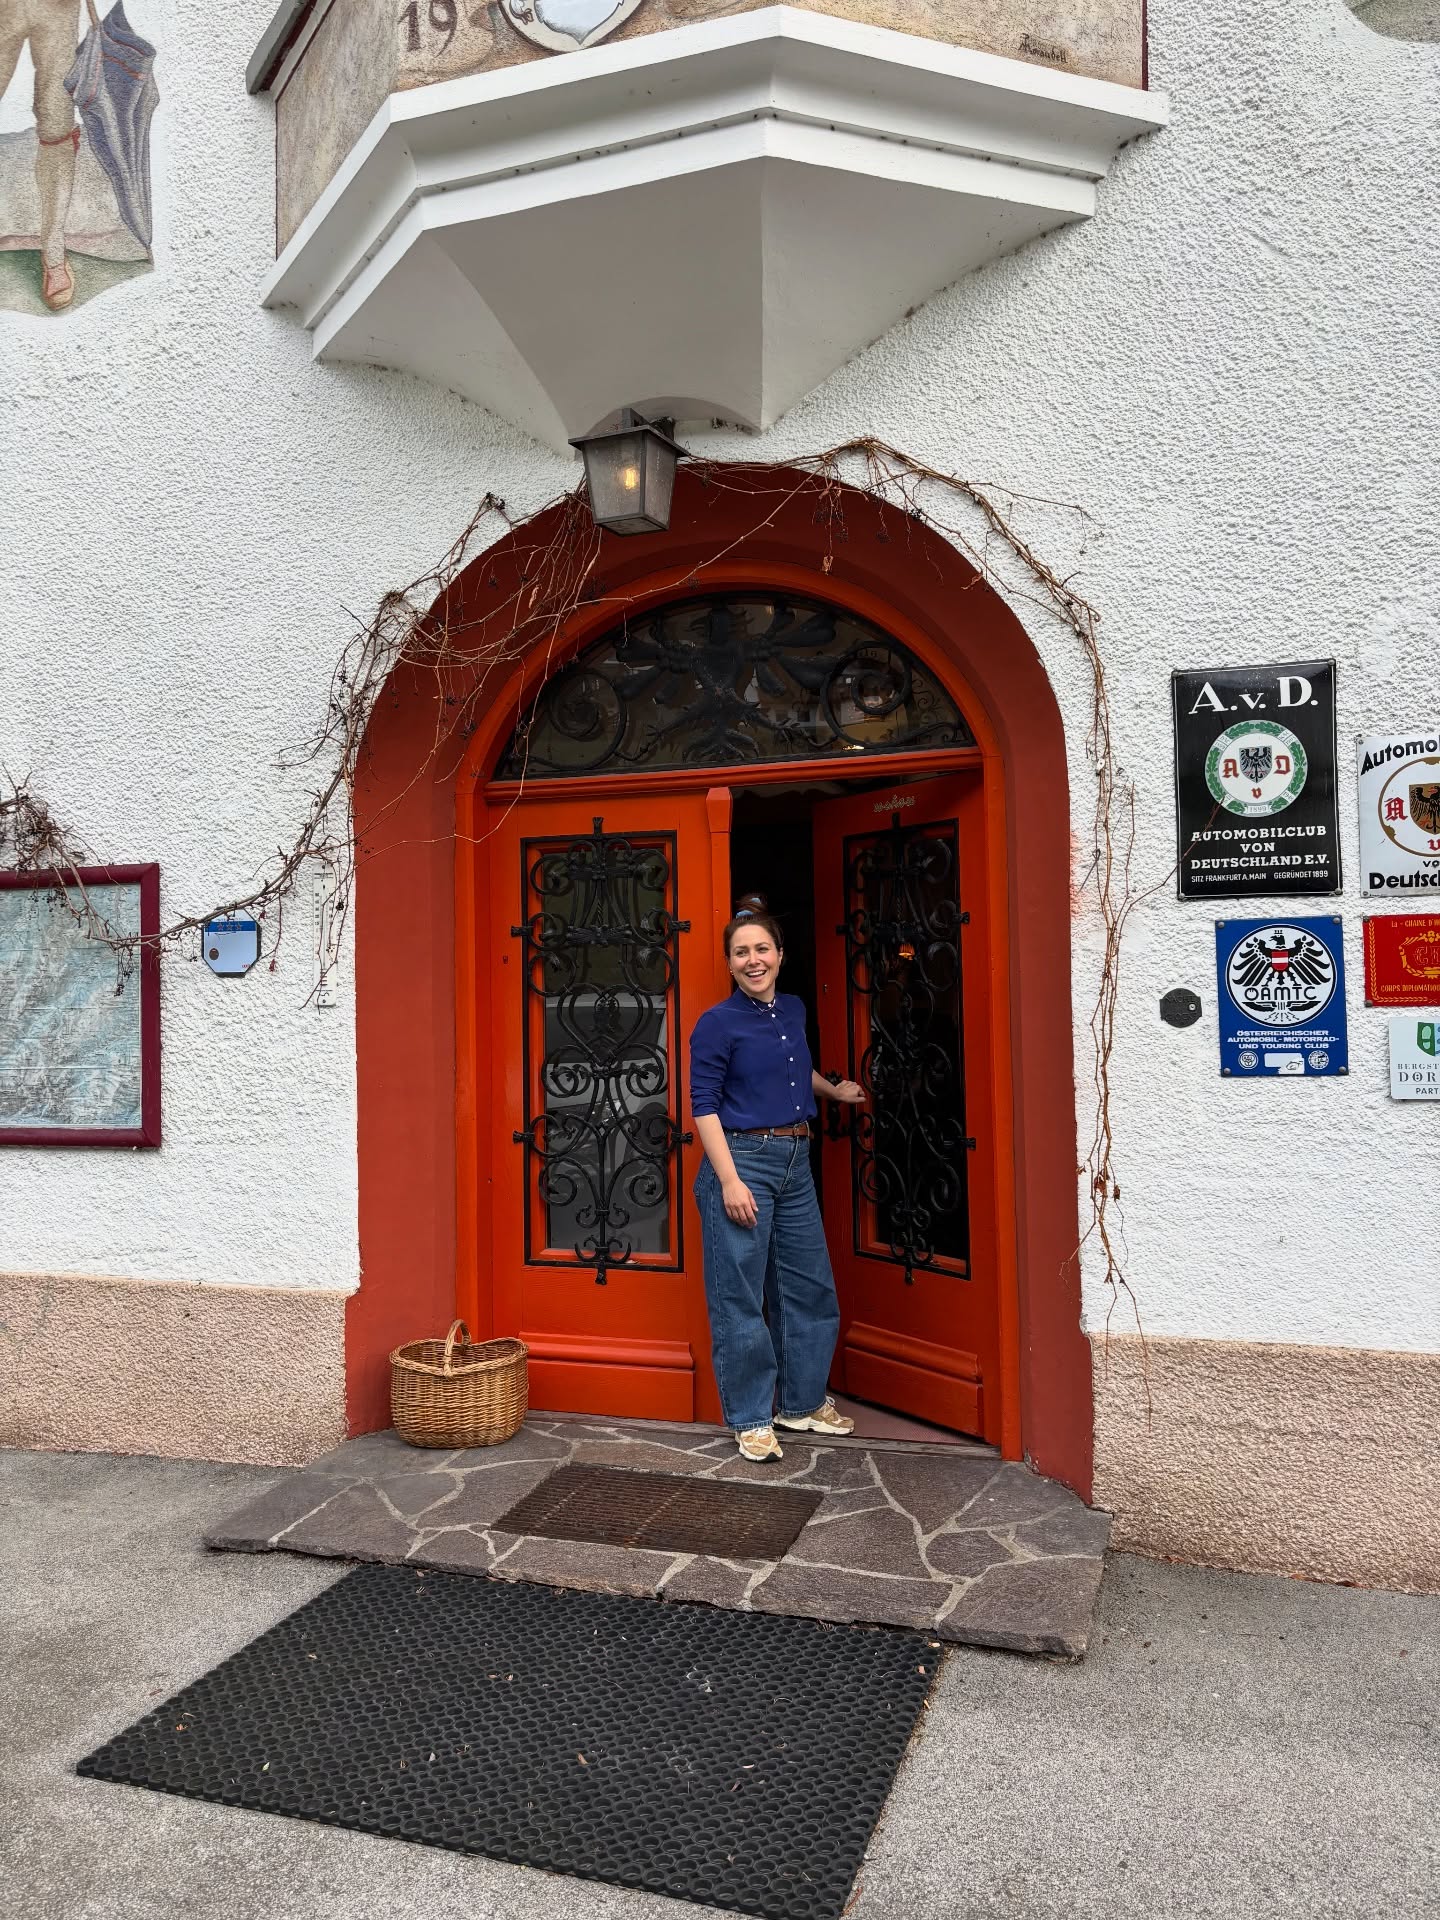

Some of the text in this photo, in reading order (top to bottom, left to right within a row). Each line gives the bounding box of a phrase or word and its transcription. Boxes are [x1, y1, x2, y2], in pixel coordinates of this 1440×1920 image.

[397, 0, 457, 57] 19
[1361, 735, 1440, 776] Automo
[1222, 755, 1291, 778] A D
[1384, 797, 1408, 822] A
[1191, 825, 1327, 841] AUTOMOBILCLUB
[1240, 842, 1276, 853] VON
[1191, 854, 1330, 869] DEUTSCHLAND E.V.
[1191, 875, 1204, 883] SITZ
[1205, 873, 1241, 882] FRANKFURT
[1273, 869, 1312, 879] GEGRÜNDET
[1312, 870, 1329, 878] 1899
[1369, 870, 1440, 889] Deutsc
[1244, 986, 1317, 1001] ÖAMTC
[1380, 984, 1400, 992] CORPS
